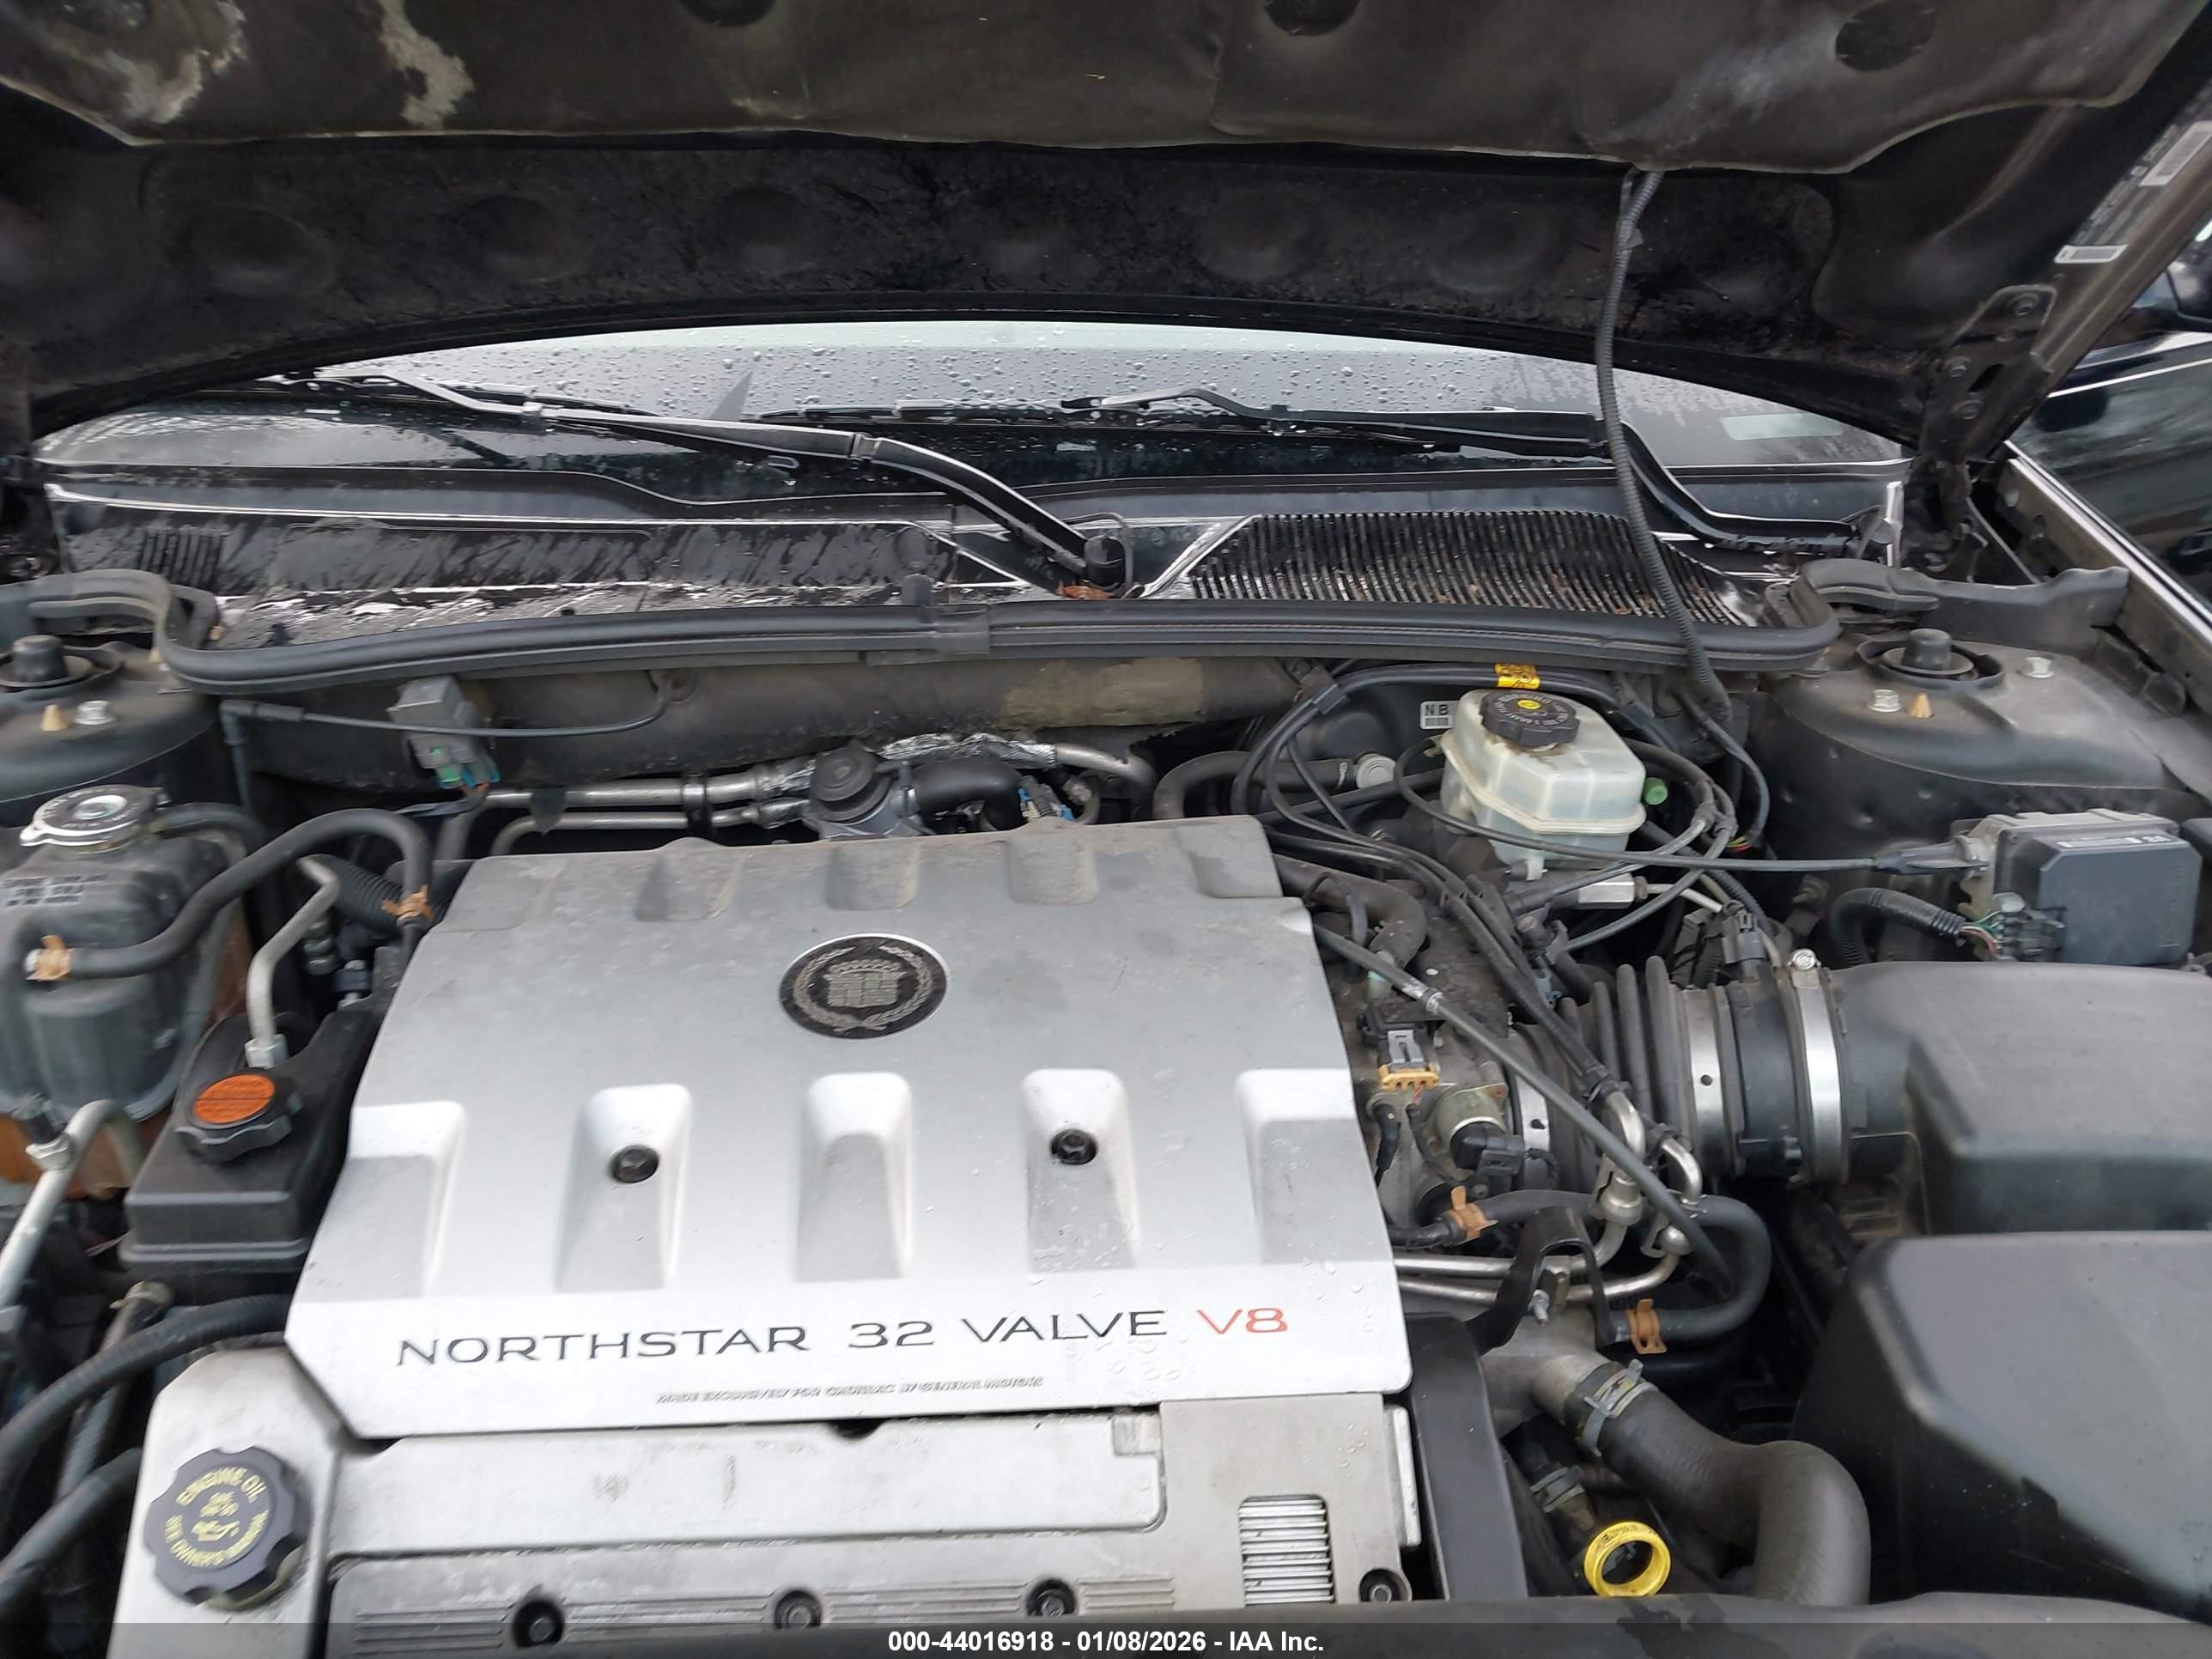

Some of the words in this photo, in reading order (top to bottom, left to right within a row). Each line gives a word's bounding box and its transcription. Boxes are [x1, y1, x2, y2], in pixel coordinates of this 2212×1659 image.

[398, 1327, 809, 1366] NORTHSTAR
[848, 1321, 934, 1348] 32
[962, 1310, 1167, 1343] VALVE
[1197, 1308, 1288, 1334] V8
